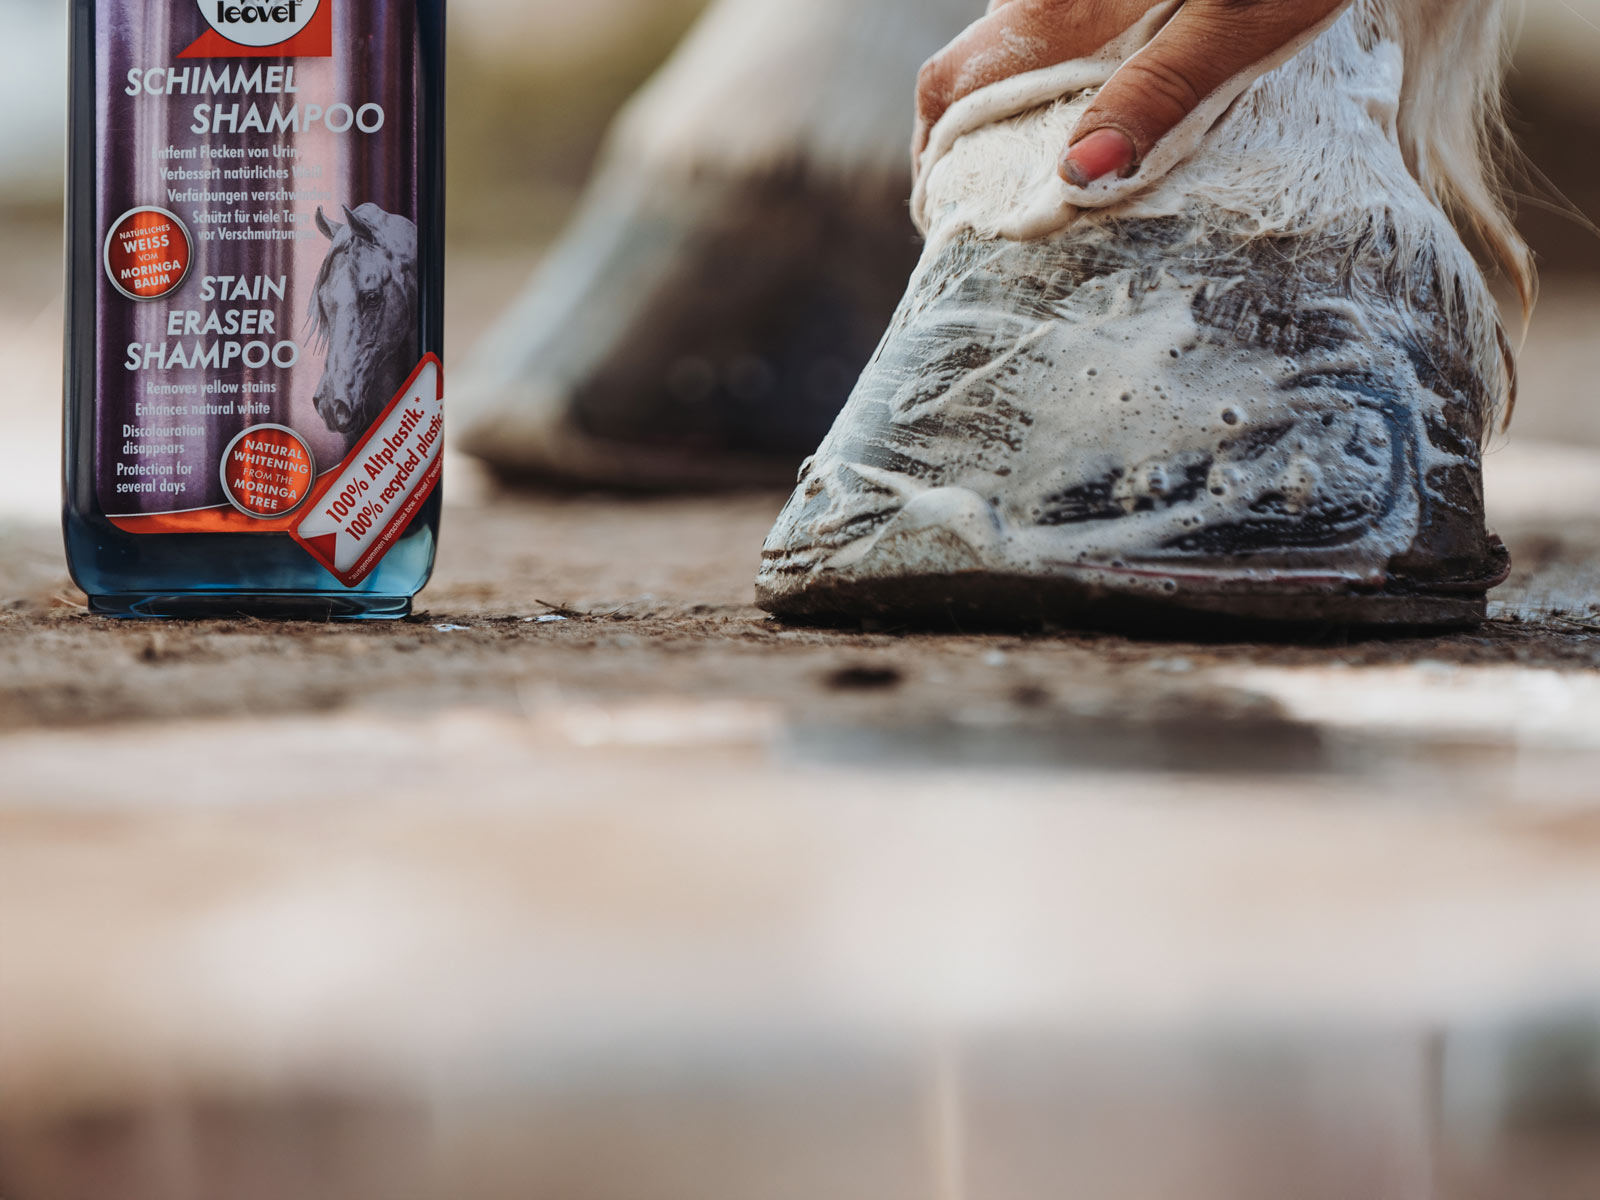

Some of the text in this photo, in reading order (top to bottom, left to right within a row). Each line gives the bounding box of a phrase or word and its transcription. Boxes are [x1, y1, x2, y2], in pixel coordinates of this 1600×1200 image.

[125, 64, 299, 96] SCHIMMEL
[190, 102, 385, 134] SHAMPOO
[152, 145, 197, 159] Entfernt
[200, 144, 245, 159] Flecken
[248, 147, 267, 158] von
[160, 166, 221, 181] Verbessert
[224, 165, 289, 179] natürliches
[168, 188, 248, 205] Verfärbungen
[193, 210, 232, 224] Schützt
[234, 209, 250, 223] für
[253, 209, 280, 223] viele
[119, 224, 170, 239] NATÜRLICHES
[198, 230, 215, 241] vor
[123, 235, 170, 254] WEISS
[138, 252, 158, 262] VOM
[121, 260, 181, 279] MORINGA
[134, 274, 171, 289] BAUM
[199, 274, 287, 301] STAIN
[167, 308, 276, 336] ERASER
[124, 340, 299, 370] SHAMPOO
[147, 379, 277, 396] Removes yellow stains
[136, 401, 271, 416] Enhances natural white
[122, 423, 205, 438] Discolouration
[122, 441, 185, 457] disappears
[244, 439, 303, 460] NATURAL
[116, 461, 192, 476] Protection for
[234, 450, 309, 474] WHITENING
[243, 467, 294, 486] FROM THE
[116, 480, 186, 495] several days
[234, 478, 297, 500] MORINGA
[345, 500, 384, 541] 100%
[379, 448, 421, 505] recycled
[249, 495, 278, 510] TREE
[325, 477, 369, 524] 100%
[382, 511, 408, 541] Verschluss
